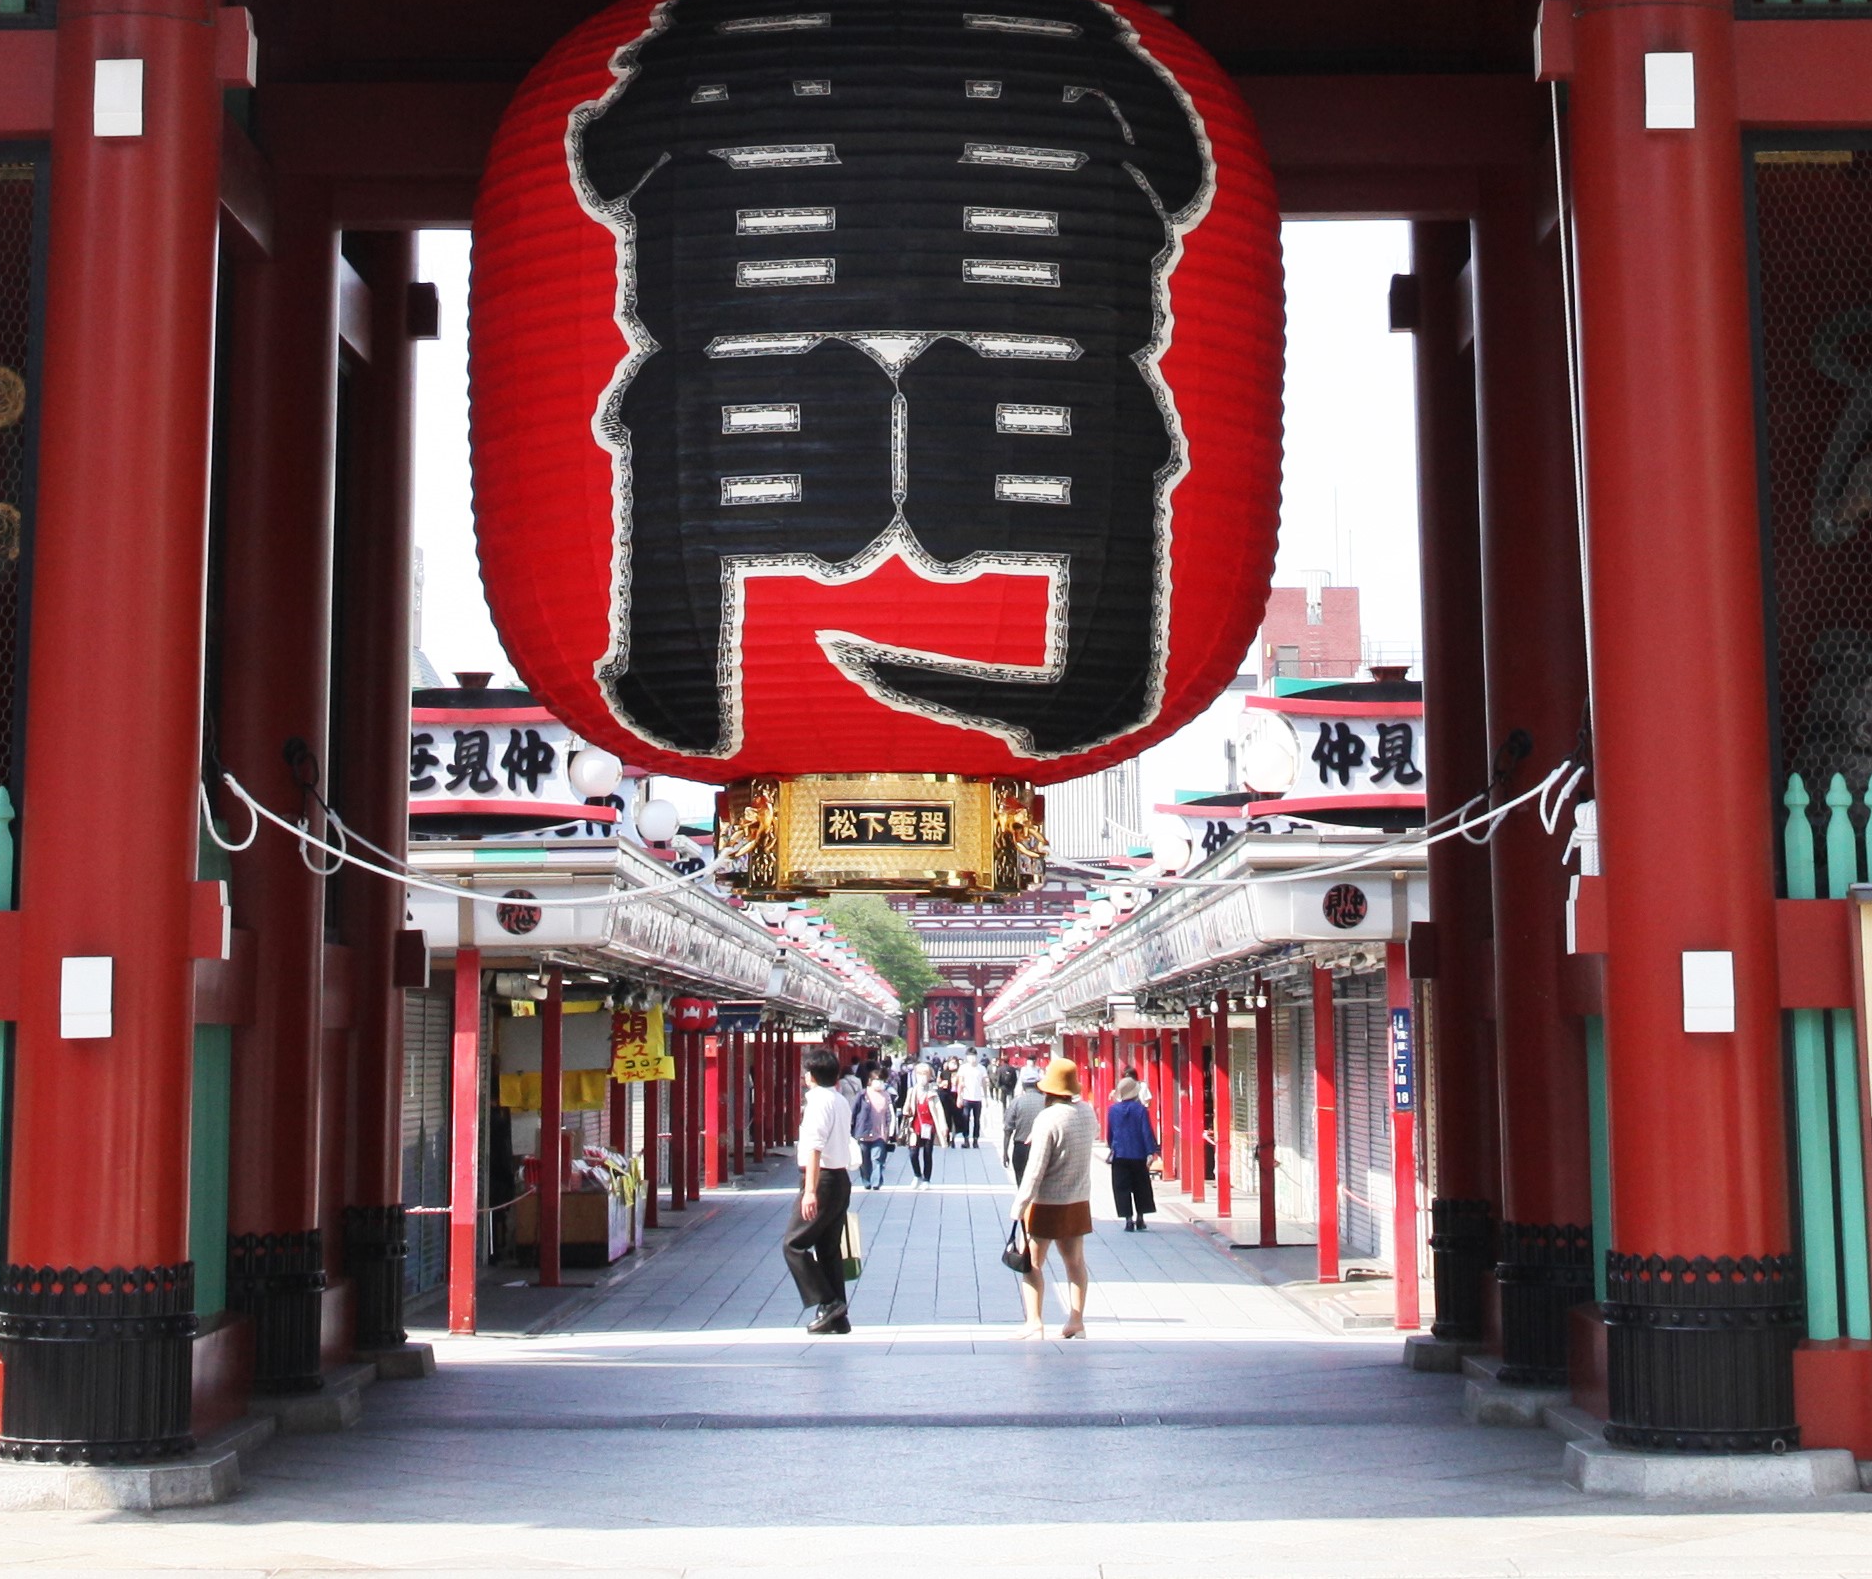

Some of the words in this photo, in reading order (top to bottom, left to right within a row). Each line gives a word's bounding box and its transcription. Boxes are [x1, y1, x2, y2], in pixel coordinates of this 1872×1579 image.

[828, 808, 947, 842] 松下電器
[1396, 1091, 1409, 1104] 18
